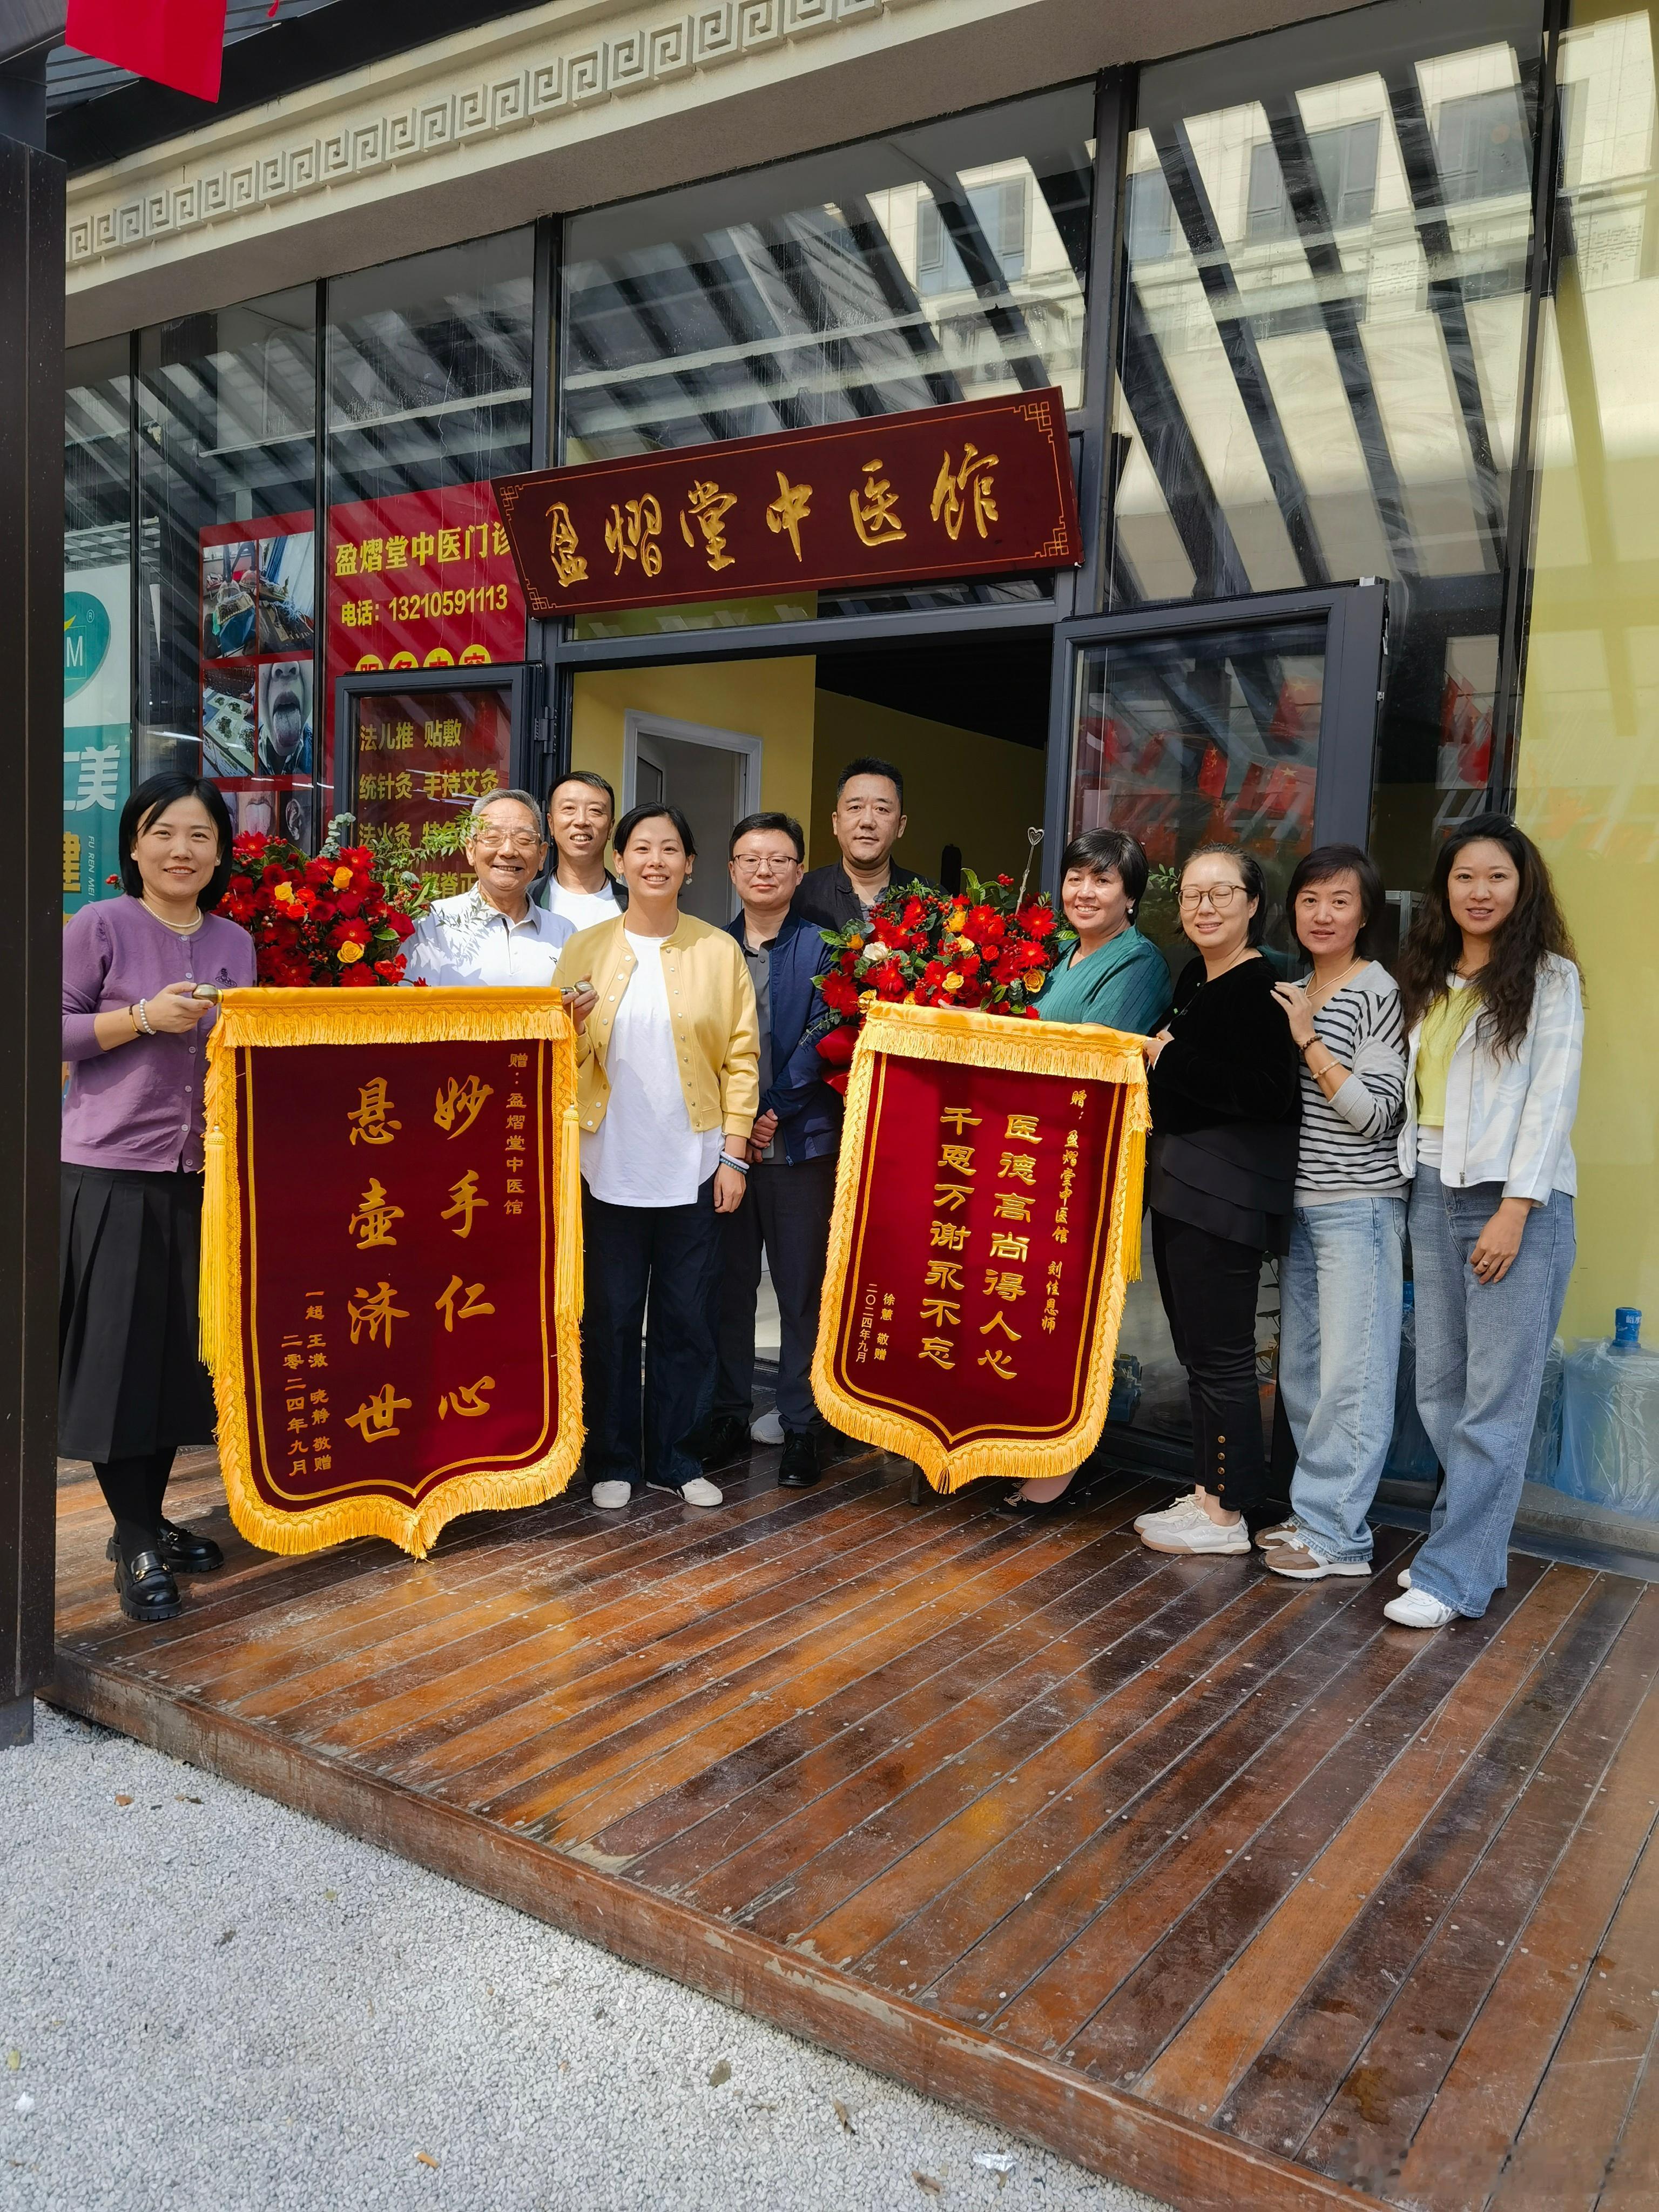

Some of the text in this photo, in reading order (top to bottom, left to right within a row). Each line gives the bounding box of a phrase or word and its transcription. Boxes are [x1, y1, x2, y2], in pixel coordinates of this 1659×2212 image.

[544, 442, 999, 588] 盈熠堂中医馆
[359, 768, 500, 801] 统针灸 手持艾灸
[423, 718, 462, 748] 贴敷
[345, 1076, 412, 1444] 悬壶济世
[434, 1074, 495, 1420] 妙手仁心
[977, 1114, 1043, 1380] 医德高尚得人心
[281, 1334, 309, 1477] 二零二四年九月
[873, 1332, 889, 1361] 敬赠
[312, 1435, 332, 1472] 敬赠
